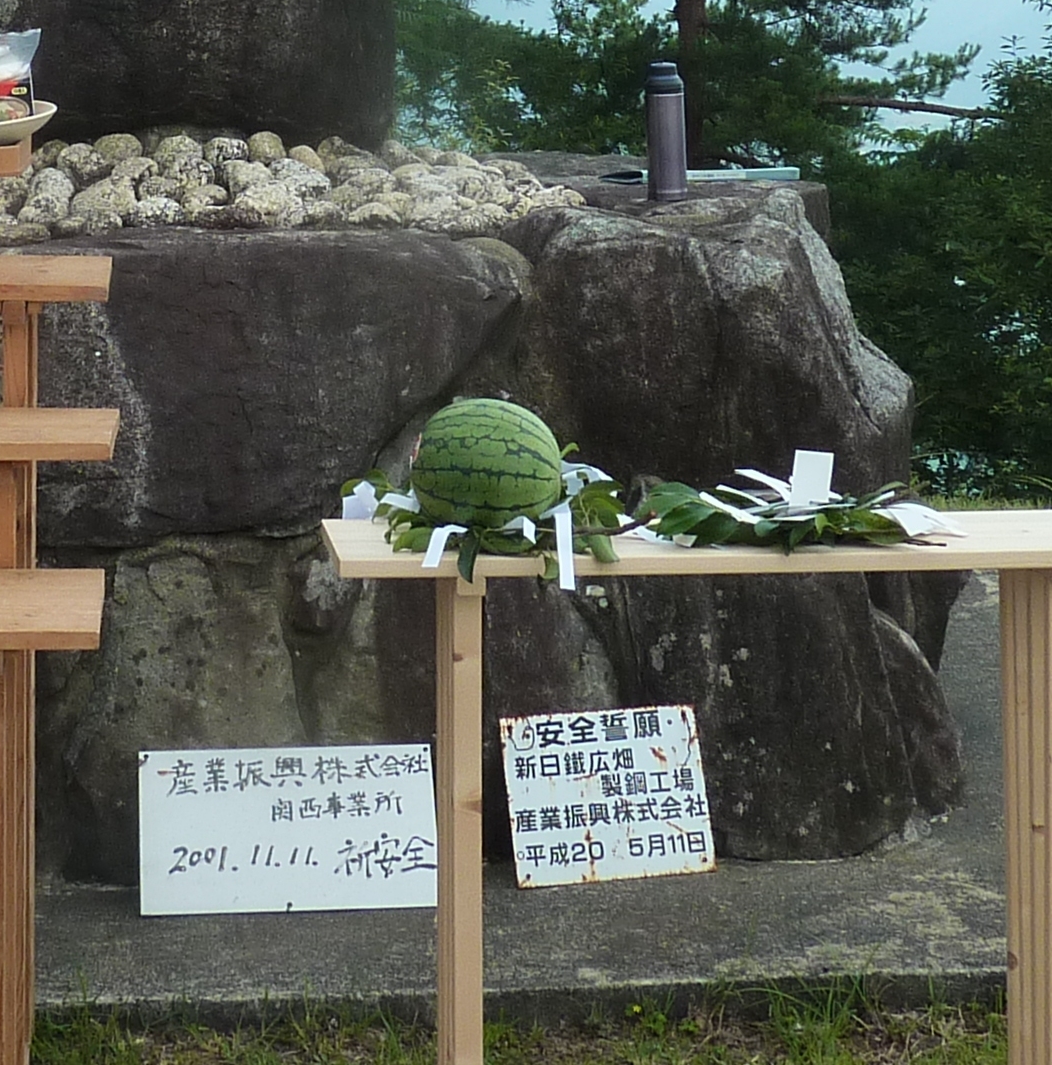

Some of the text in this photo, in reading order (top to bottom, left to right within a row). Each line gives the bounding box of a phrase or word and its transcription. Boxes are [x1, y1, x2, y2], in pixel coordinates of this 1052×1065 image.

[536, 710, 662, 748] 安全誓願
[166, 753, 429, 797] 産業振興株式会社
[514, 748, 634, 781] 新日鐵広畑
[600, 768, 694, 798] 製鋼工場
[515, 793, 707, 833] 産業振興株式会社
